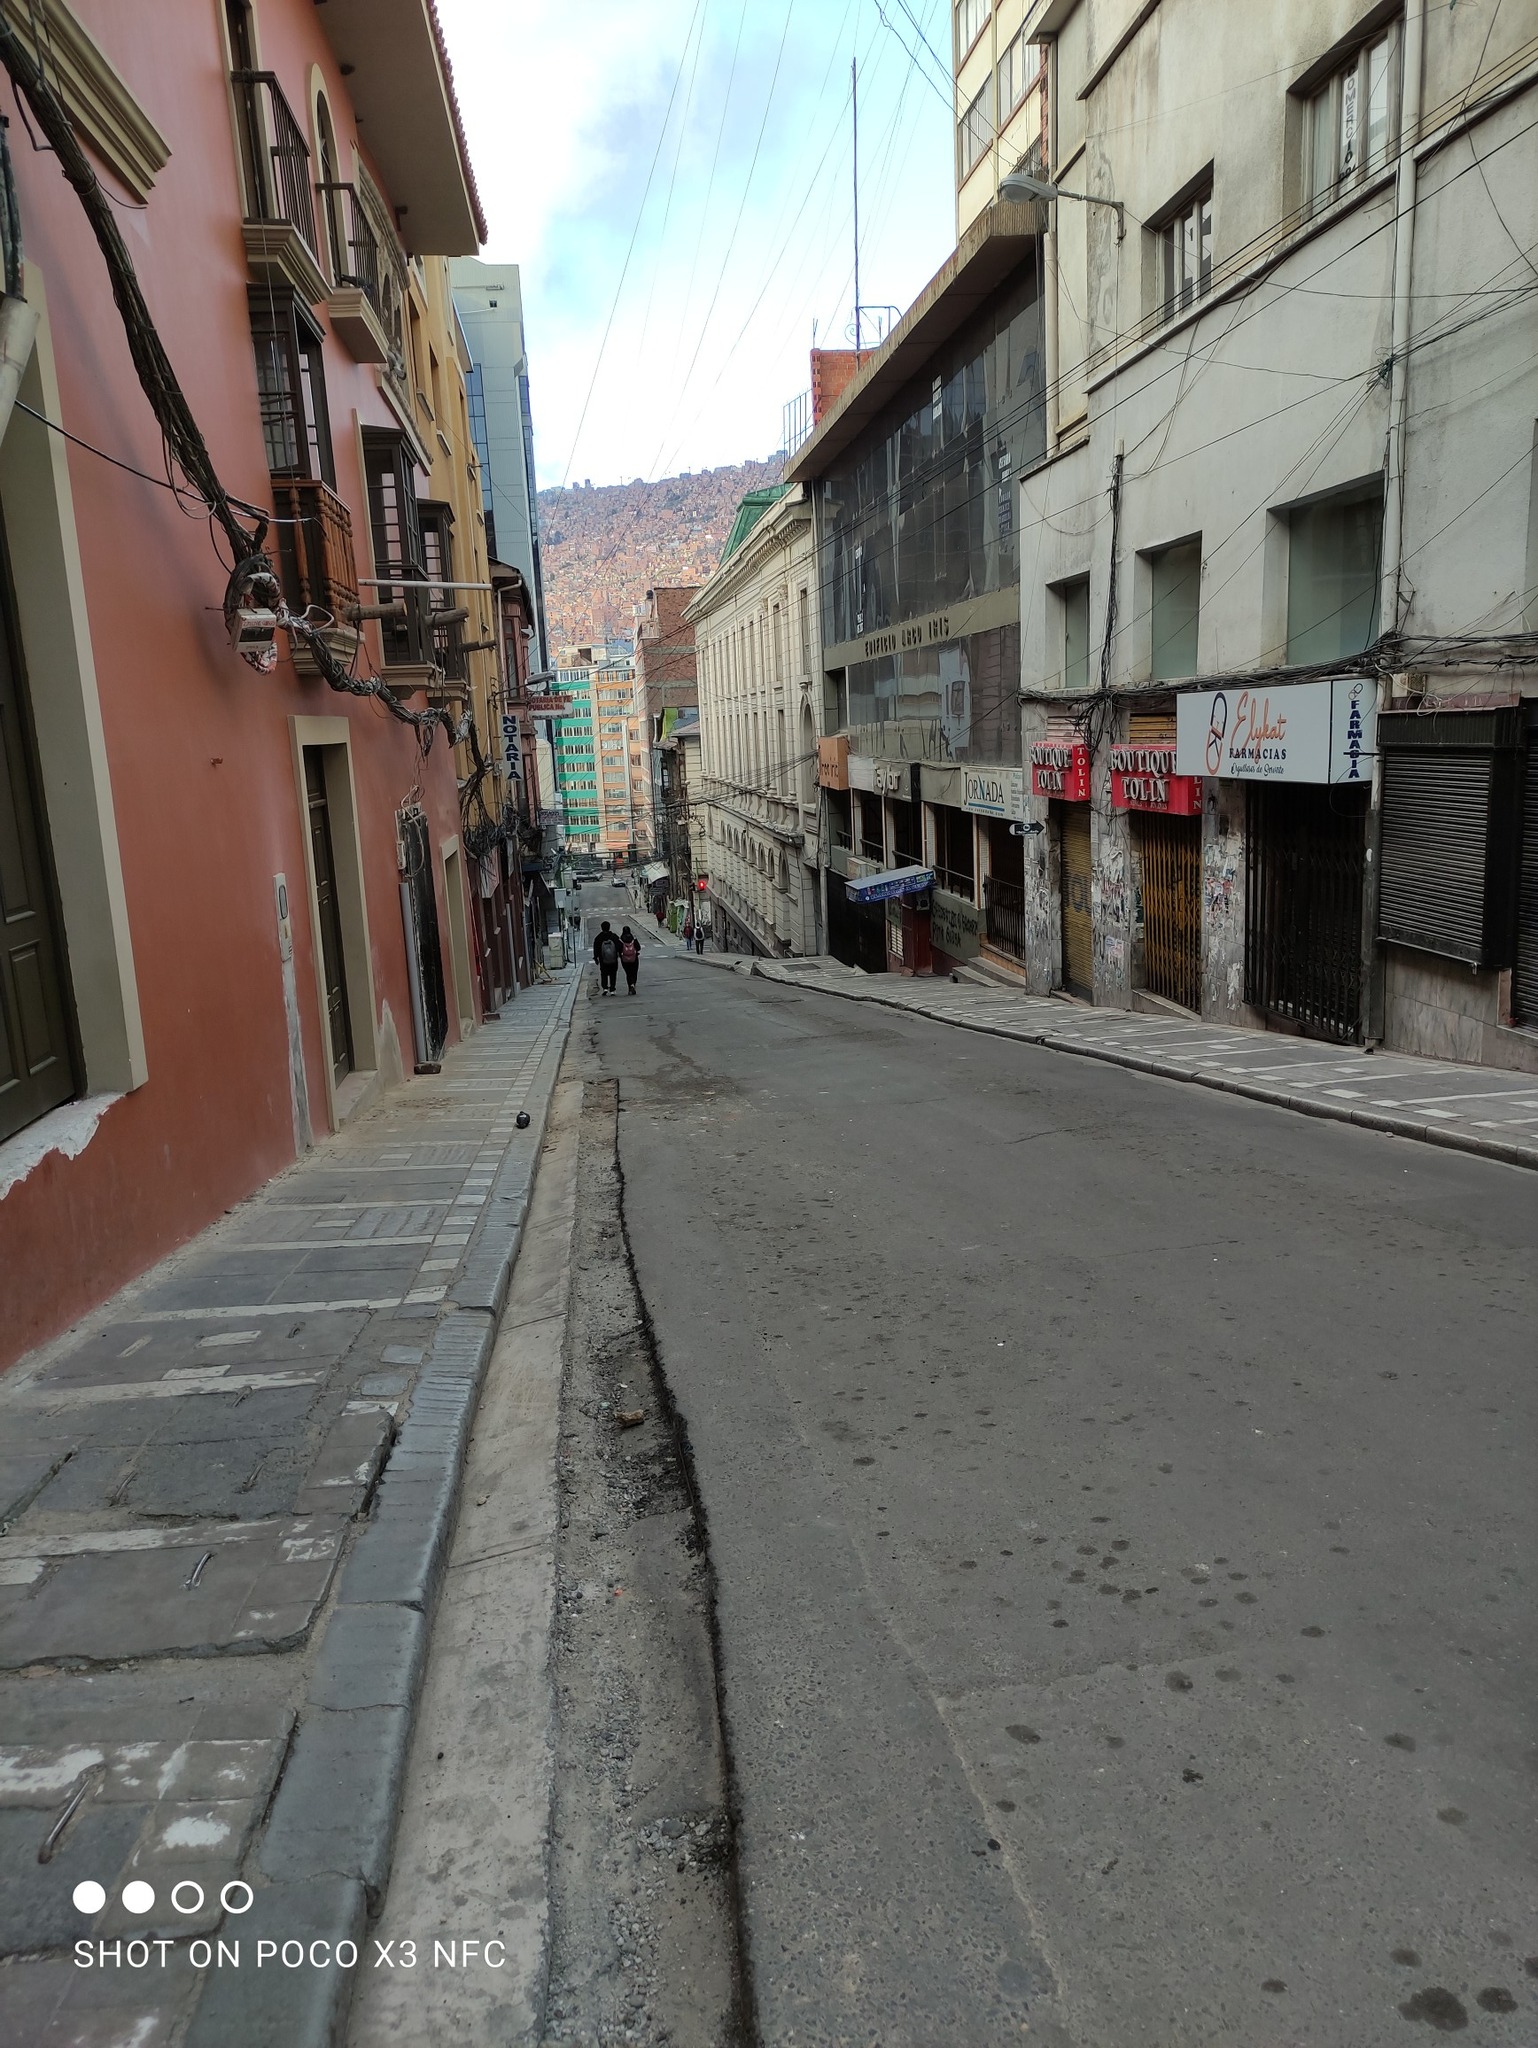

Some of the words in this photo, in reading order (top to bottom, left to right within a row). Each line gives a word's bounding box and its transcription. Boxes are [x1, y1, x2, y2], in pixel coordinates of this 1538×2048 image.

[865, 633, 897, 658] EDIFICIO
[502, 715, 522, 780] NOTARIA
[1231, 691, 1287, 765] Elykat
[1347, 700, 1363, 779] FARMACIA
[1029, 746, 1070, 771] BOUTIQUE
[1077, 748, 1086, 797] TOLIN
[1229, 748, 1287, 760] FARMACIAS
